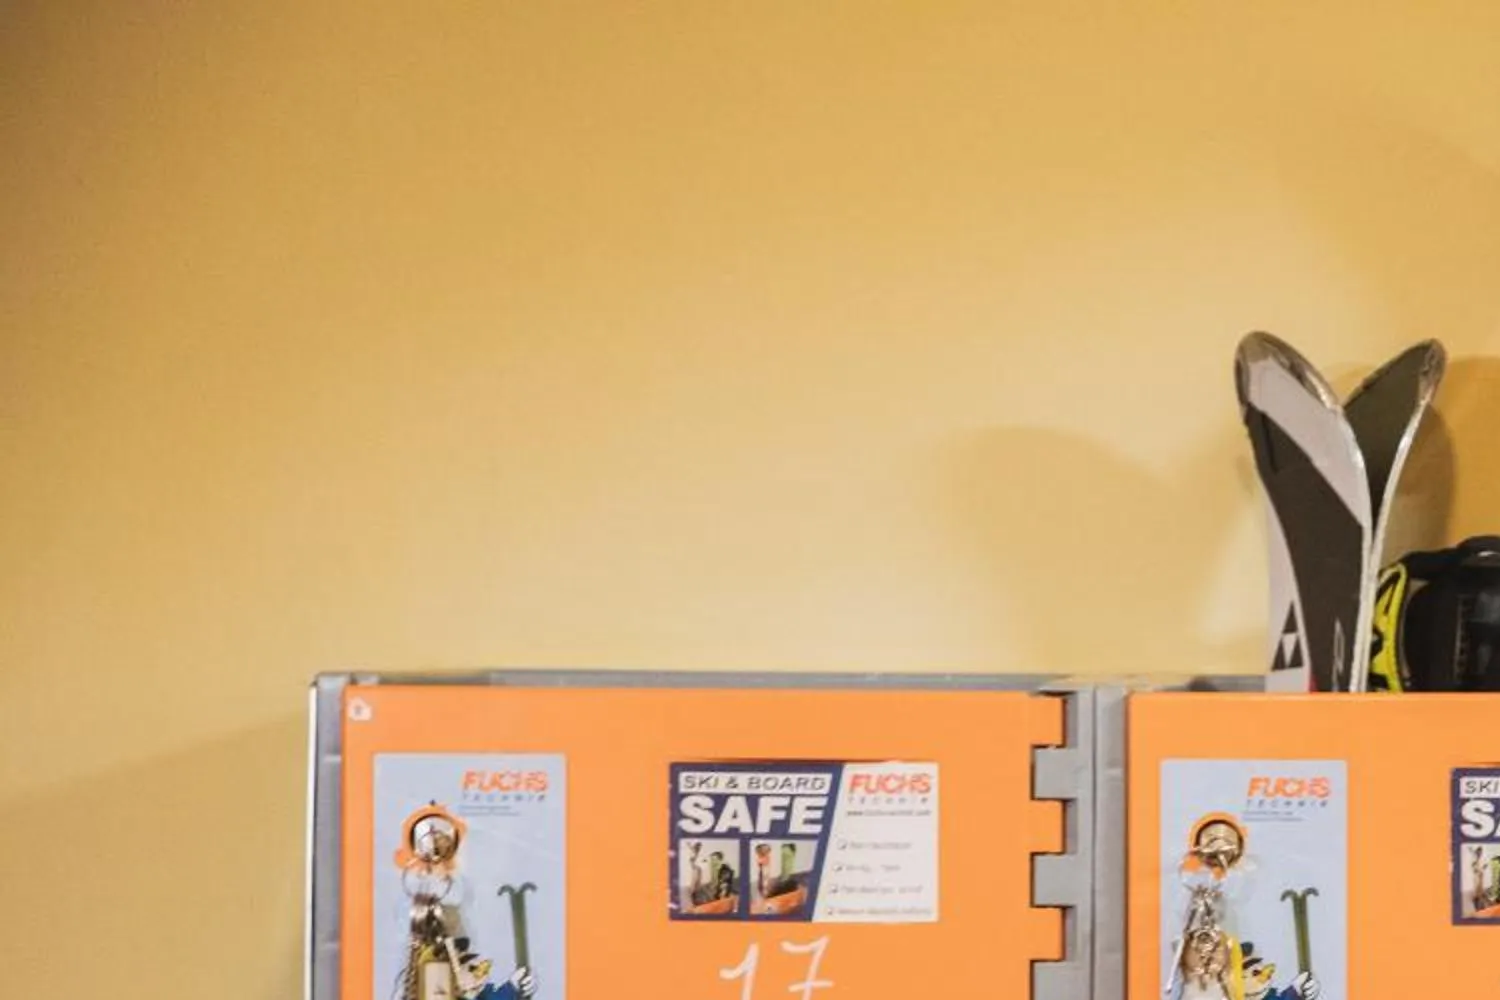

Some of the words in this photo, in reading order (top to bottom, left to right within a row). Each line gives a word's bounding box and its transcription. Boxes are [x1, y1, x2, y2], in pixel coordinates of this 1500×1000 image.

[463, 769, 549, 793] FUCHS
[682, 775, 717, 790] SKI
[724, 775, 739, 790] &
[747, 775, 828, 791] BOARD
[849, 773, 932, 795] FUCHS
[1247, 776, 1330, 798] FUCHS
[1463, 779, 1499, 794] SKI
[678, 795, 830, 835] SAFE
